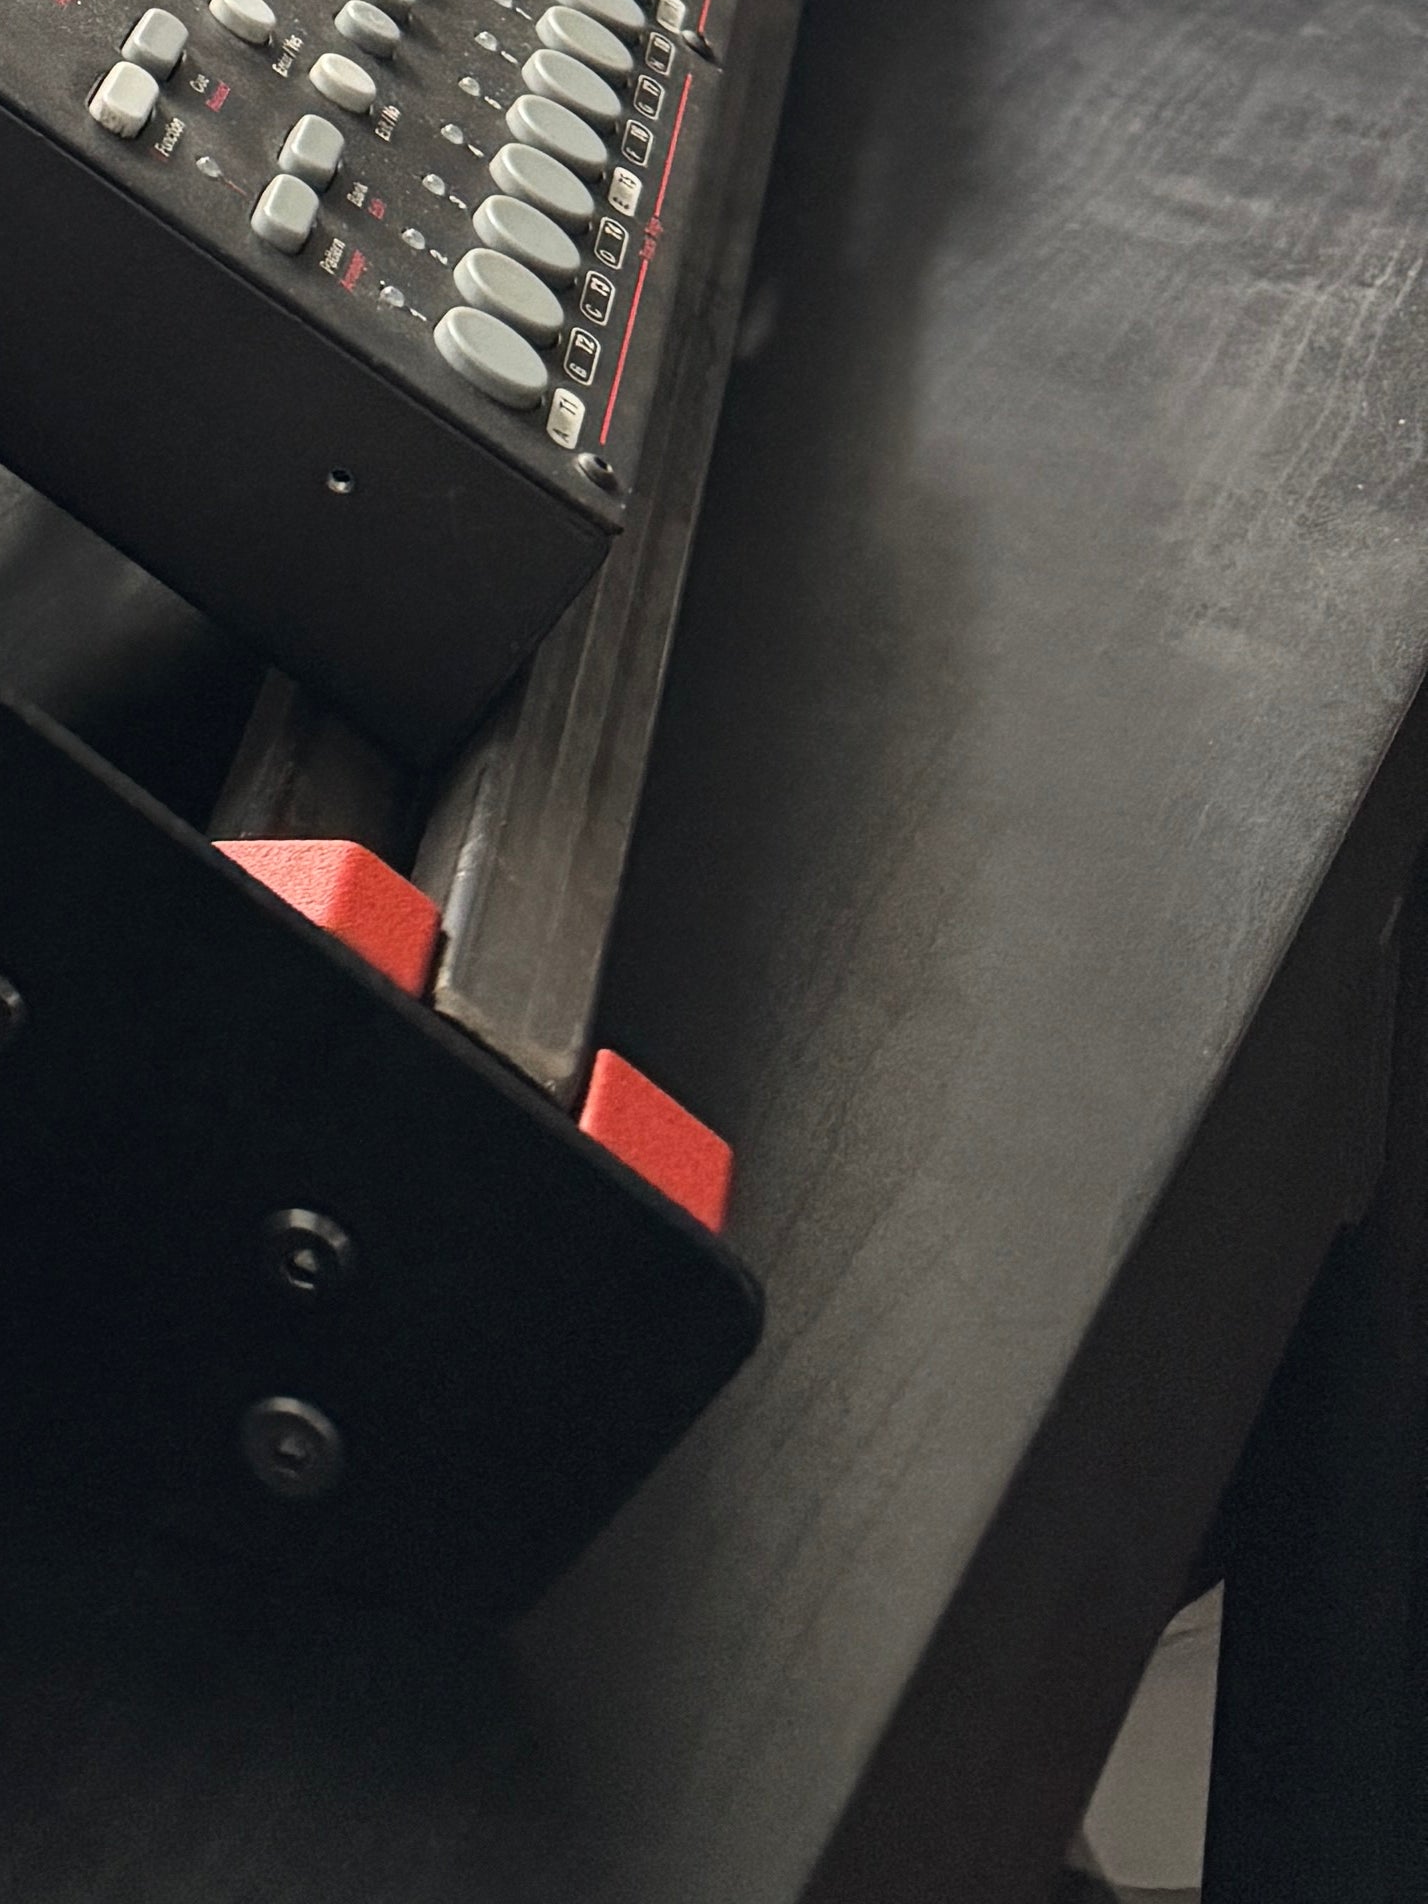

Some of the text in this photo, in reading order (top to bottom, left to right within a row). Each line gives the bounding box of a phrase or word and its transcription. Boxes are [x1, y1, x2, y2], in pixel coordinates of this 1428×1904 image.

[189, 74, 210, 93] Cue
[154, 117, 187, 157] Function
[346, 182, 369, 208] Bank
[319, 237, 346, 275] Pattern
[588, 274, 609, 298] T3
[574, 331, 597, 356] T2
[556, 393, 580, 418] T1
